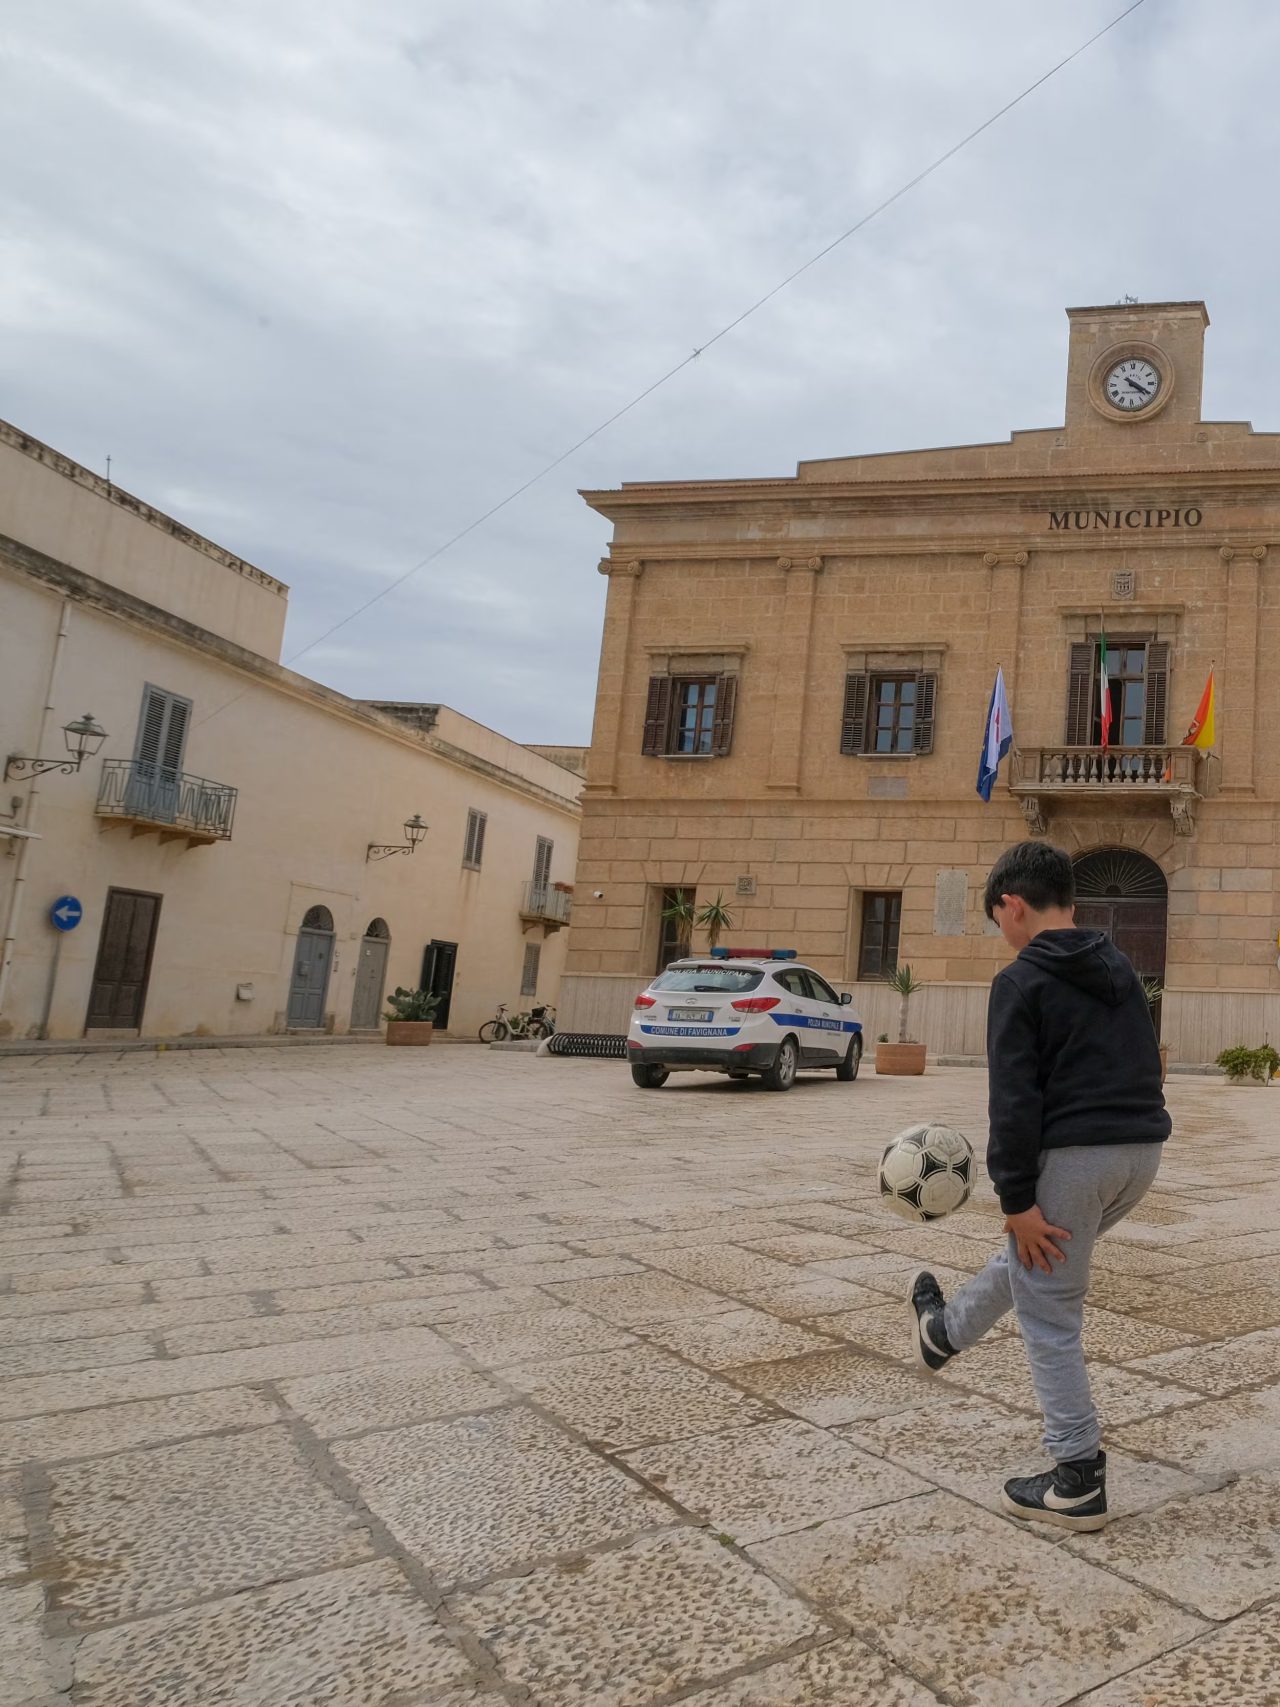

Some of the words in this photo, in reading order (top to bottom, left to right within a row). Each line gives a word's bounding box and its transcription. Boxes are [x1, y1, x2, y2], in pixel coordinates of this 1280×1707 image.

[1048, 508, 1203, 530] MUNICIPIO
[700, 968, 752, 978] MUNICIPALE
[650, 1027, 678, 1035] COMUNE
[688, 1028, 728, 1036] FAVIGNANA
